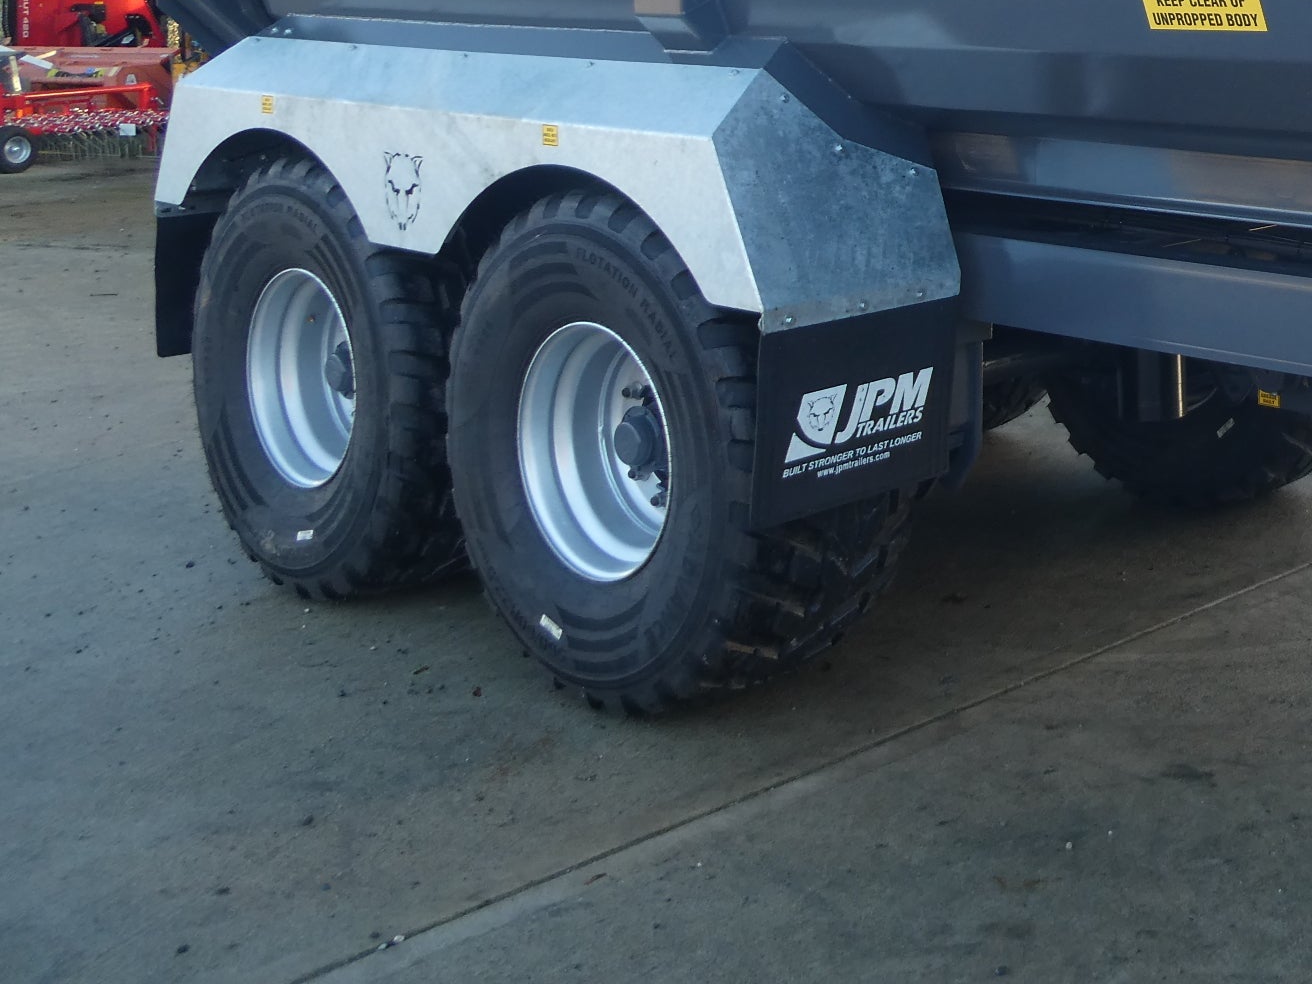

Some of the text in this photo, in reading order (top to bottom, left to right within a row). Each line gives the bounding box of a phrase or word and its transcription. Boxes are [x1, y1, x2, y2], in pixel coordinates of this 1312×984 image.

[1153, 12, 1258, 27] UNPROPPED BODY
[576, 247, 639, 299] FLOTATION
[834, 366, 934, 444] JPM
[856, 407, 924, 438] TRAILERS
[782, 431, 922, 478] BUILT STRONGER TO LAST LONGER
[817, 451, 890, 478] www.jpmtrailers.com
